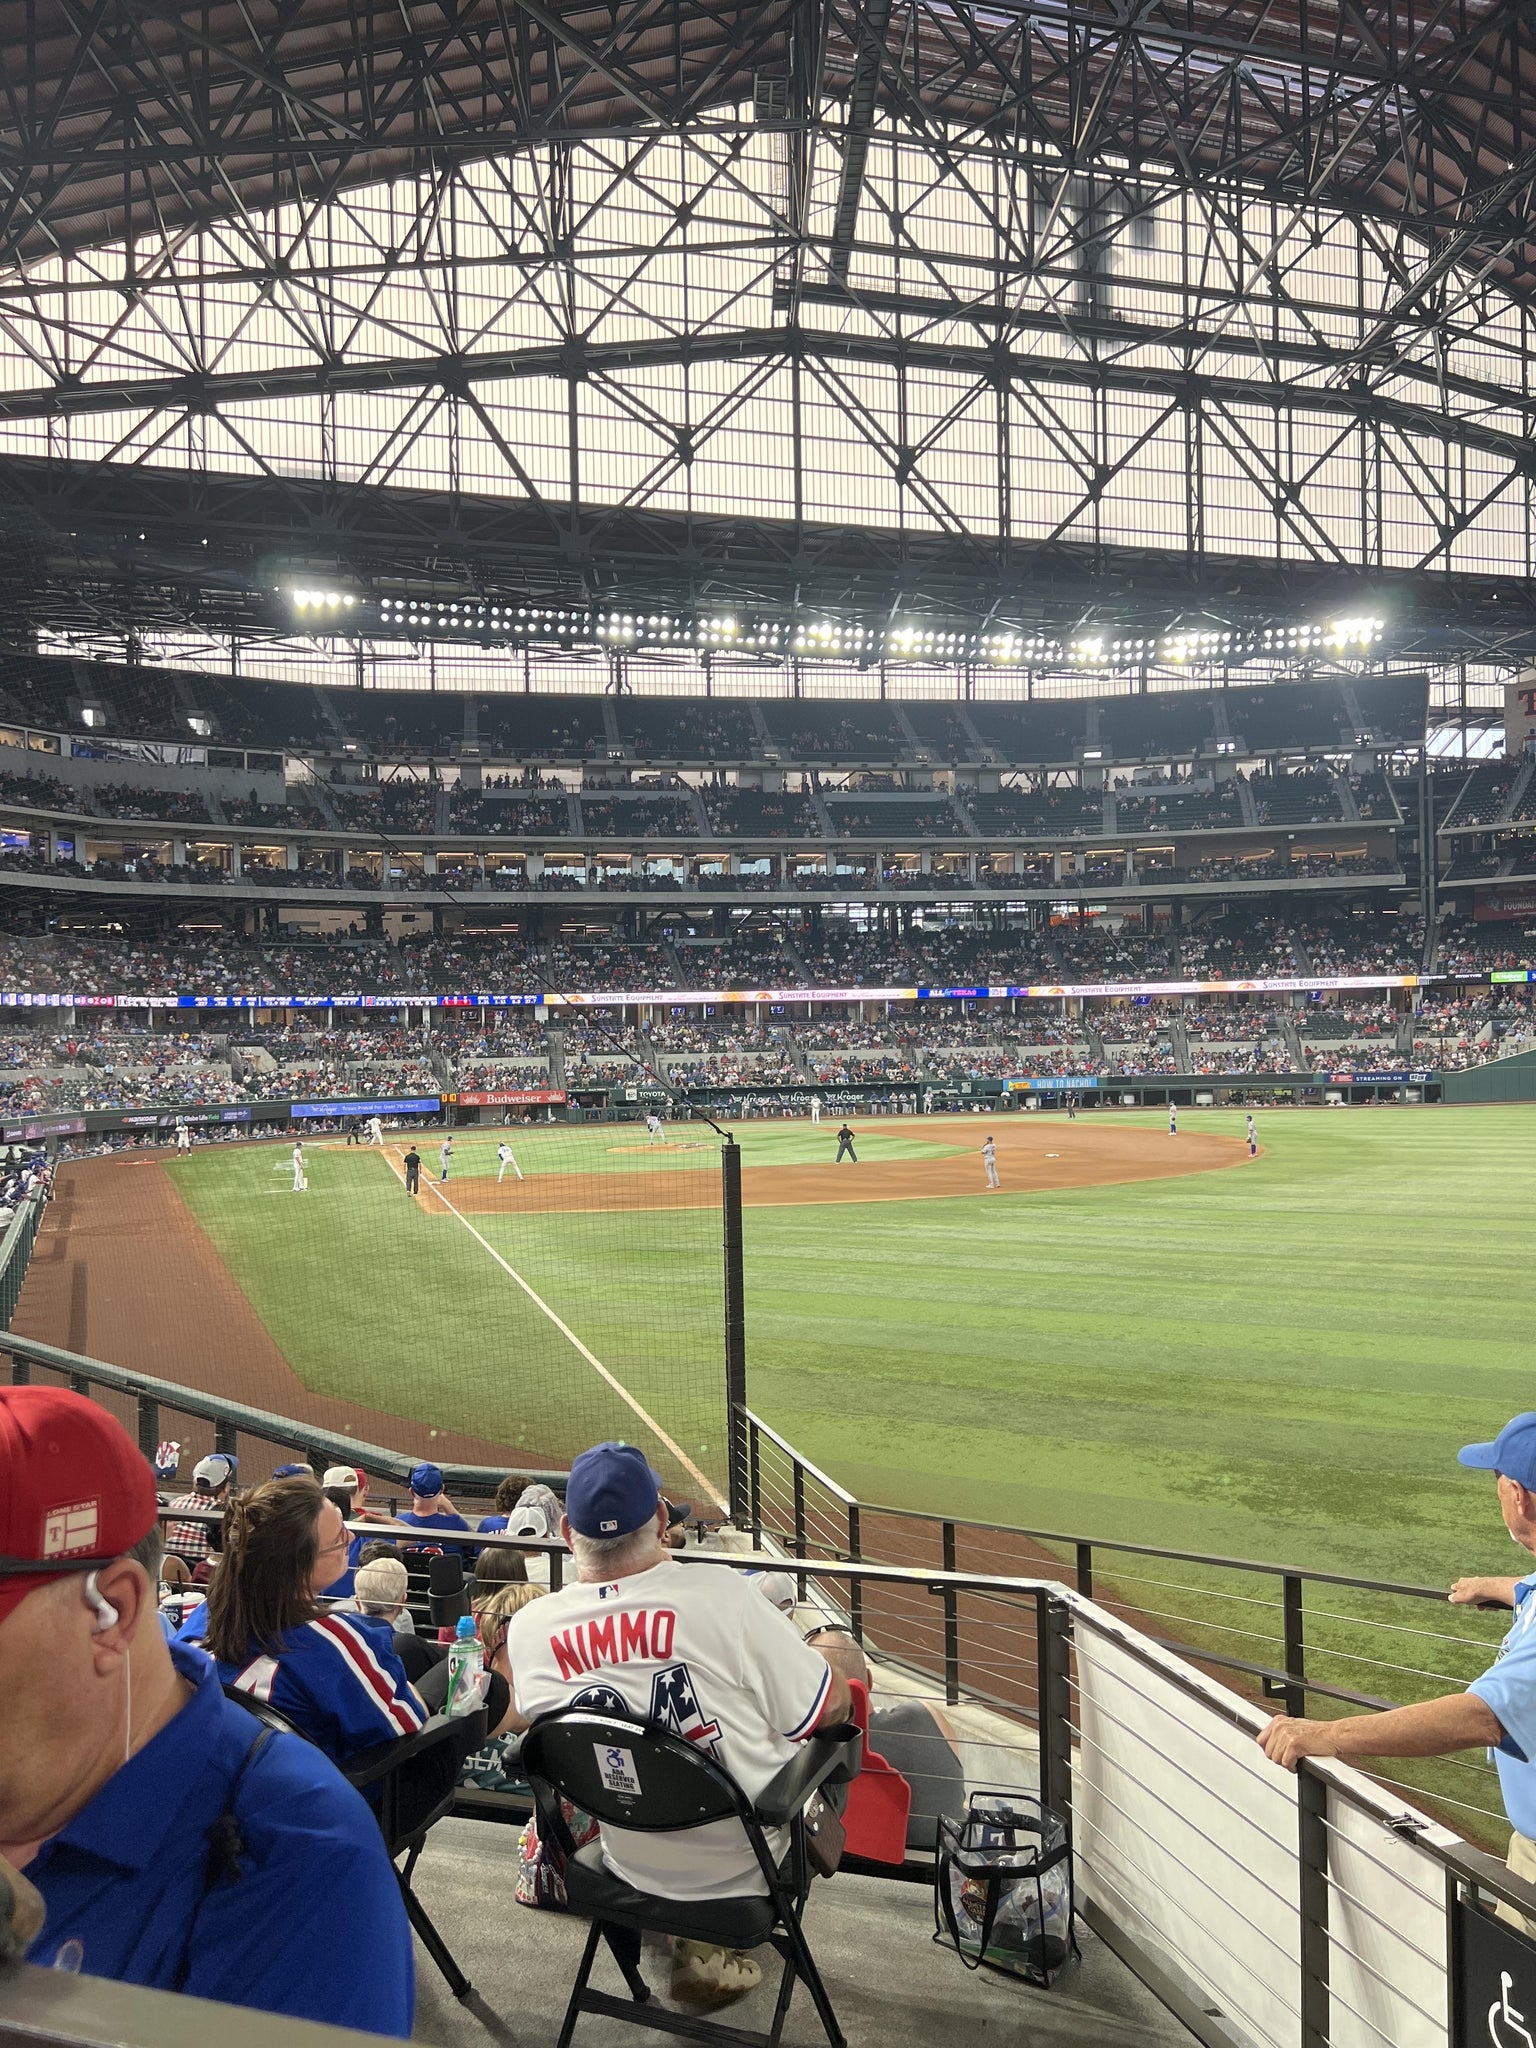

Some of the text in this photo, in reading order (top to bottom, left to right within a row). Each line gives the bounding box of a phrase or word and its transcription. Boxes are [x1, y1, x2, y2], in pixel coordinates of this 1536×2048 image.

[1056, 1080, 1063, 1088] TO
[487, 1093, 544, 1105] Budweiser
[837, 1090, 864, 1101] Kroger
[47, 1500, 97, 1517] LONE STAR
[50, 1526, 61, 1542] T
[550, 1610, 676, 1681] NIMMO
[612, 1768, 624, 1776] ADA
[604, 1773, 635, 1784] RESERVED
[608, 1780, 634, 1789] SEATING
